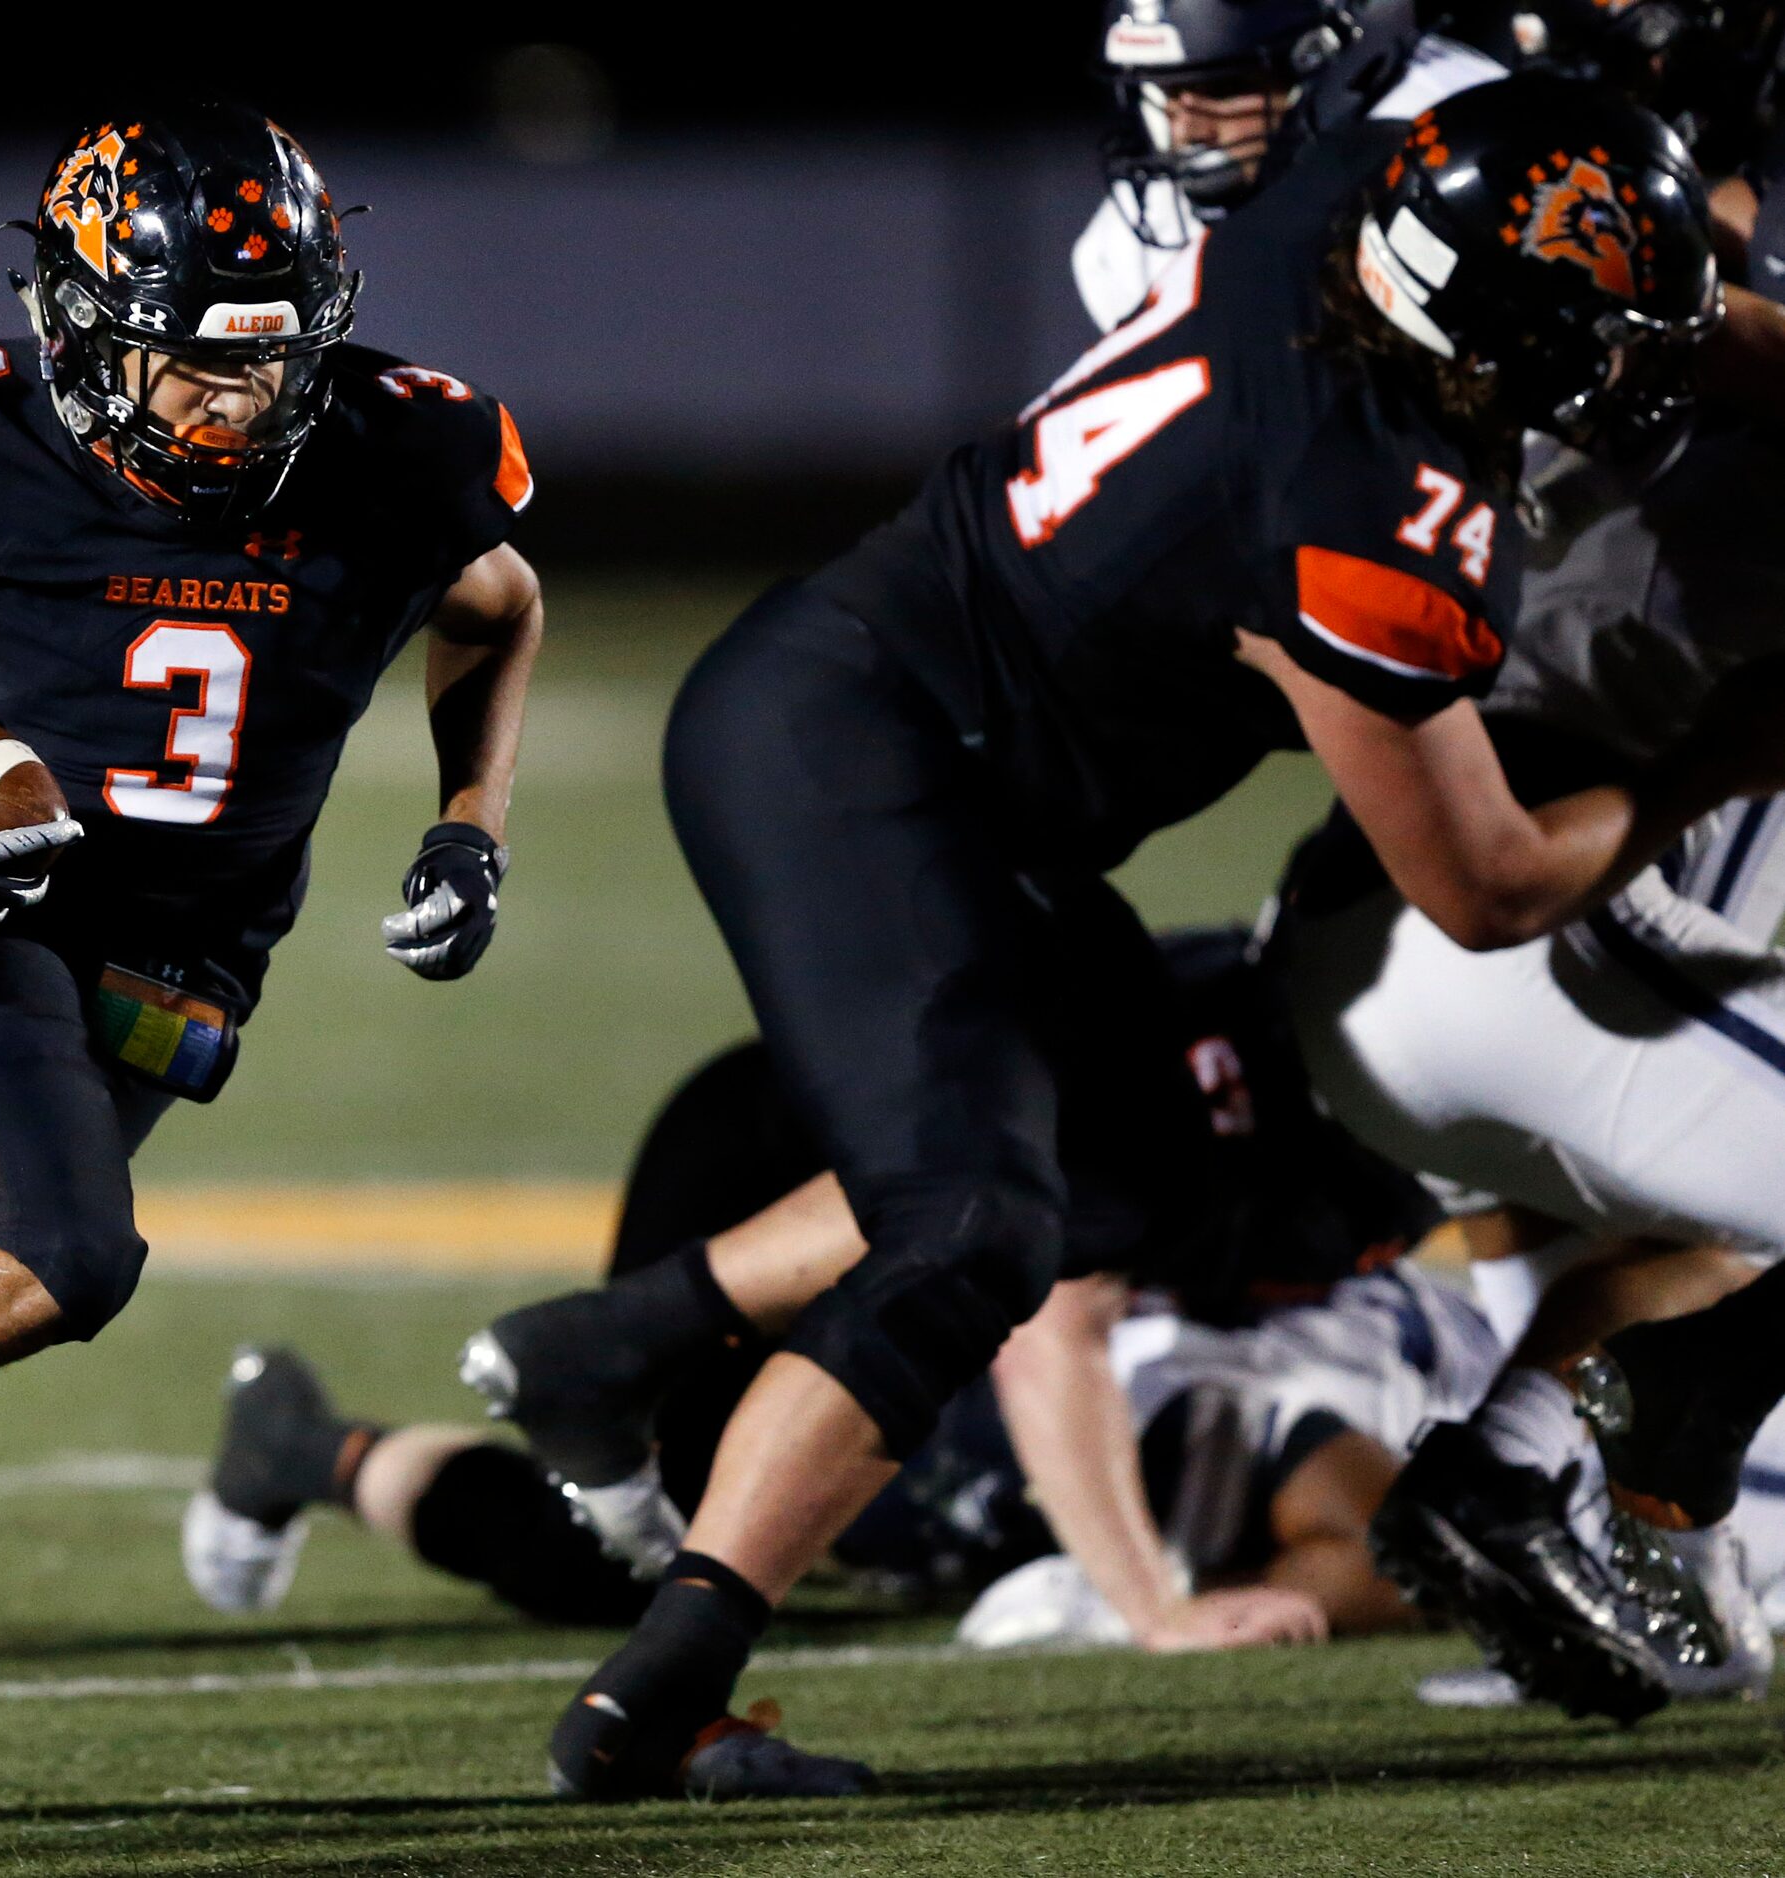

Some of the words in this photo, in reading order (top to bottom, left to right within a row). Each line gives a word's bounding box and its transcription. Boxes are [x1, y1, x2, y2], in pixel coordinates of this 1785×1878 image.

[225, 315, 284, 332] ALEDO
[377, 365, 473, 401] 3
[1394, 462, 1496, 588] 74
[105, 575, 291, 613] BEARCATS
[102, 619, 253, 825] 3
